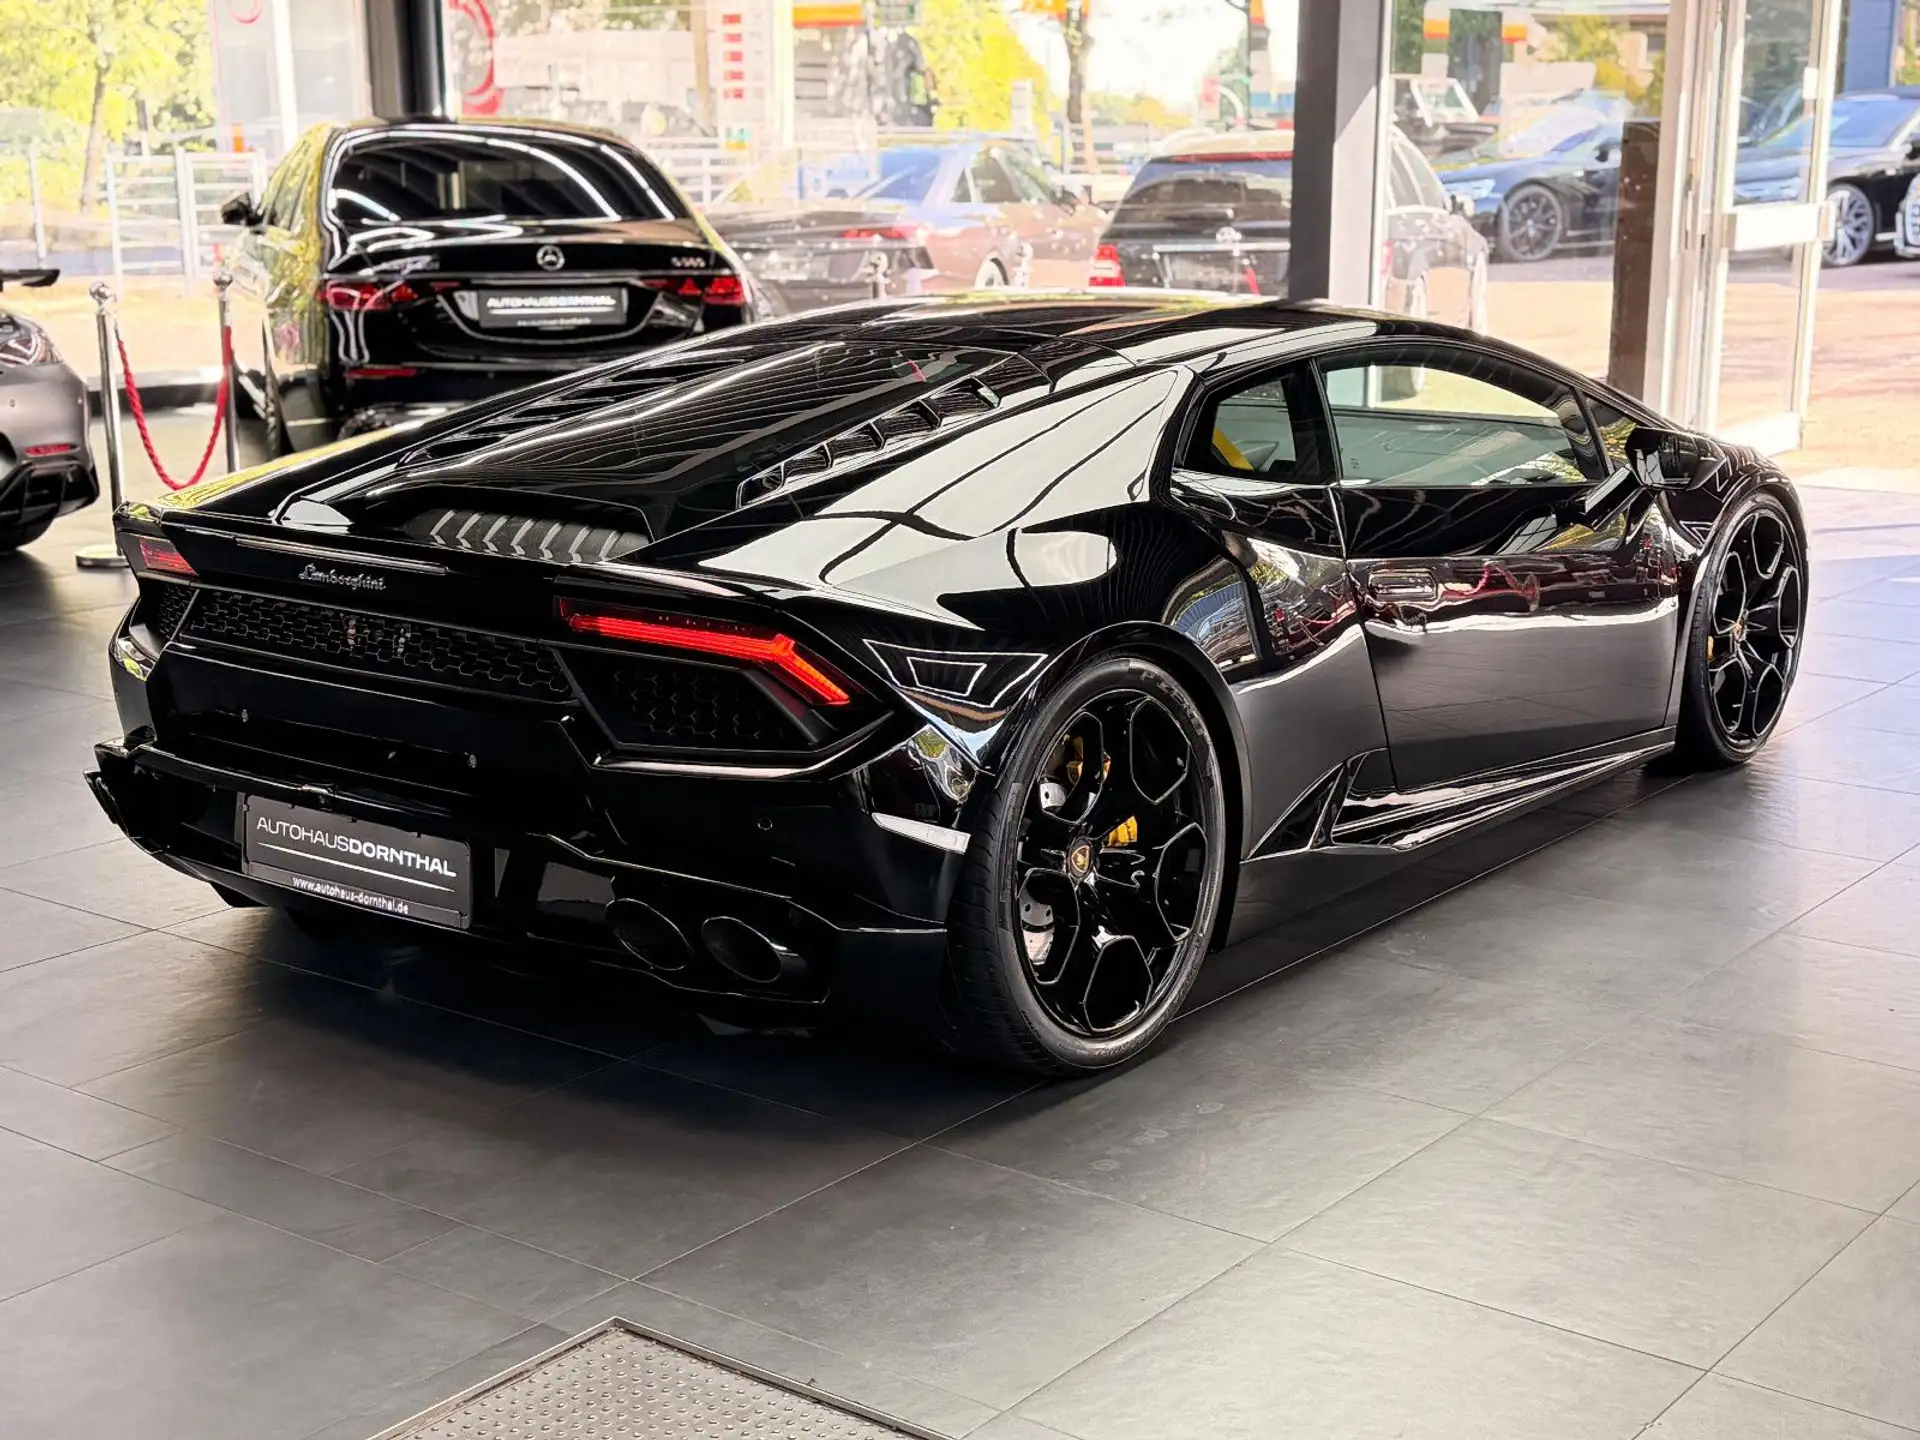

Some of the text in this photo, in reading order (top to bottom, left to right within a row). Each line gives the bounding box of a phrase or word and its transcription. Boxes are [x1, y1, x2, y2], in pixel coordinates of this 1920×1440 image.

[299, 563, 386, 590] Lamborghini
[257, 816, 457, 877] AUTOHAUSDORNTHAL
[292, 876, 409, 914] www.autohaus-dornthal.de
